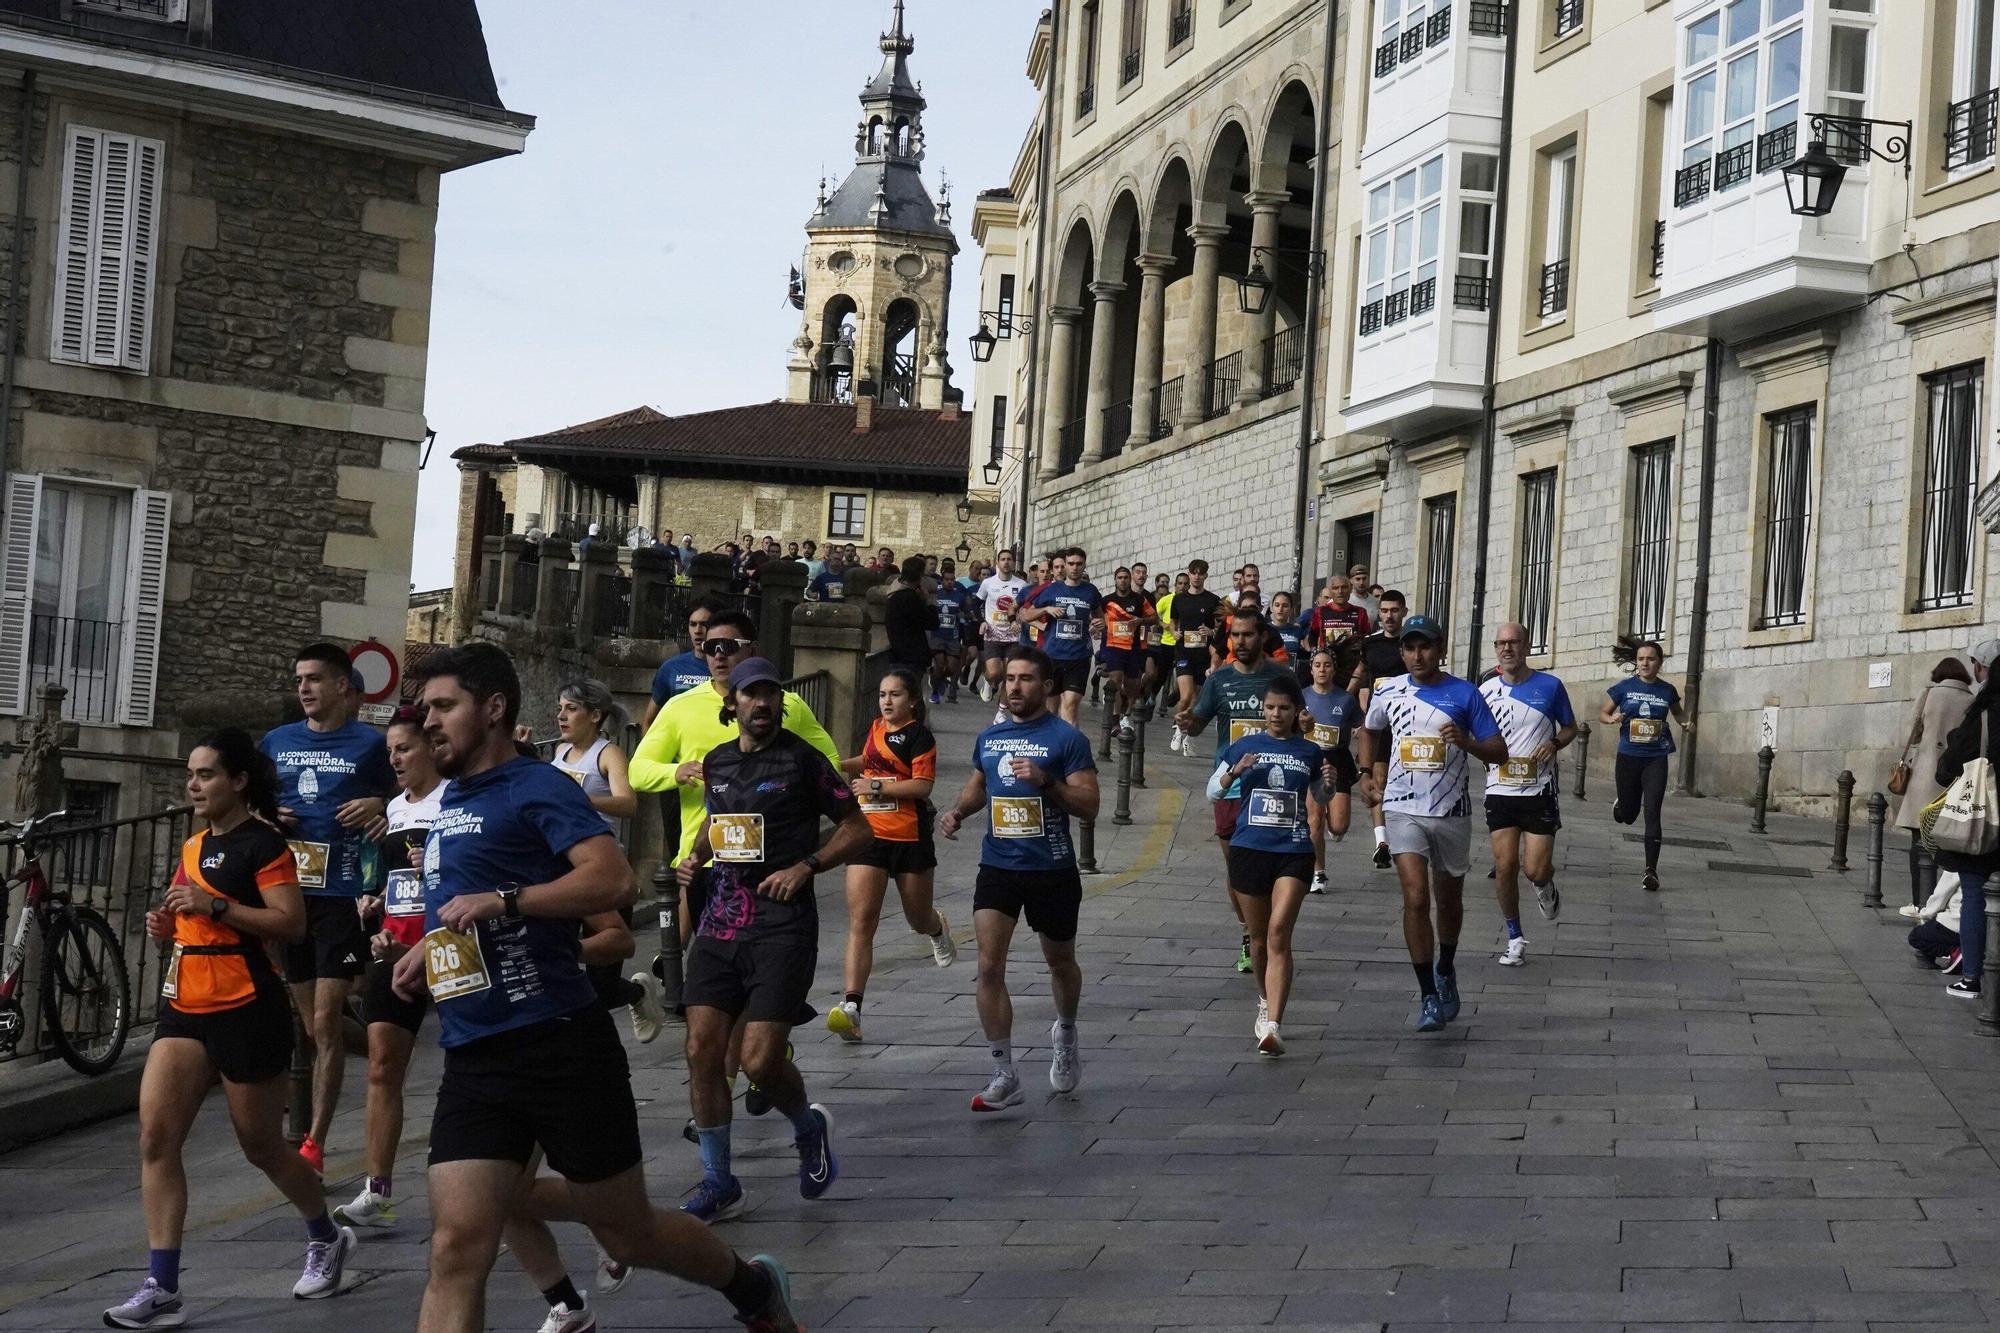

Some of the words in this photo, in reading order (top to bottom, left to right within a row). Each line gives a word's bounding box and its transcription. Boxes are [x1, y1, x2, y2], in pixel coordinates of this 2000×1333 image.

[990, 743, 1039, 752] ALMENDRA
[1014, 750, 1048, 758] KONKISTA
[1411, 744, 1435, 758] 667
[277, 751, 286, 759] LA
[286, 751, 331, 759] CONQUISTA
[1258, 756, 1306, 767] ALMENDRA
[286, 757, 346, 767] ALMENDRA
[316, 765, 356, 775] KONKISTA
[1507, 763, 1529, 775] 683
[1262, 798, 1285, 814] 795
[1002, 807, 1029, 823] 353
[441, 823, 482, 838] KONKISTA
[721, 825, 746, 844] 143
[395, 879, 419, 899] 883
[430, 943, 461, 975] 626
